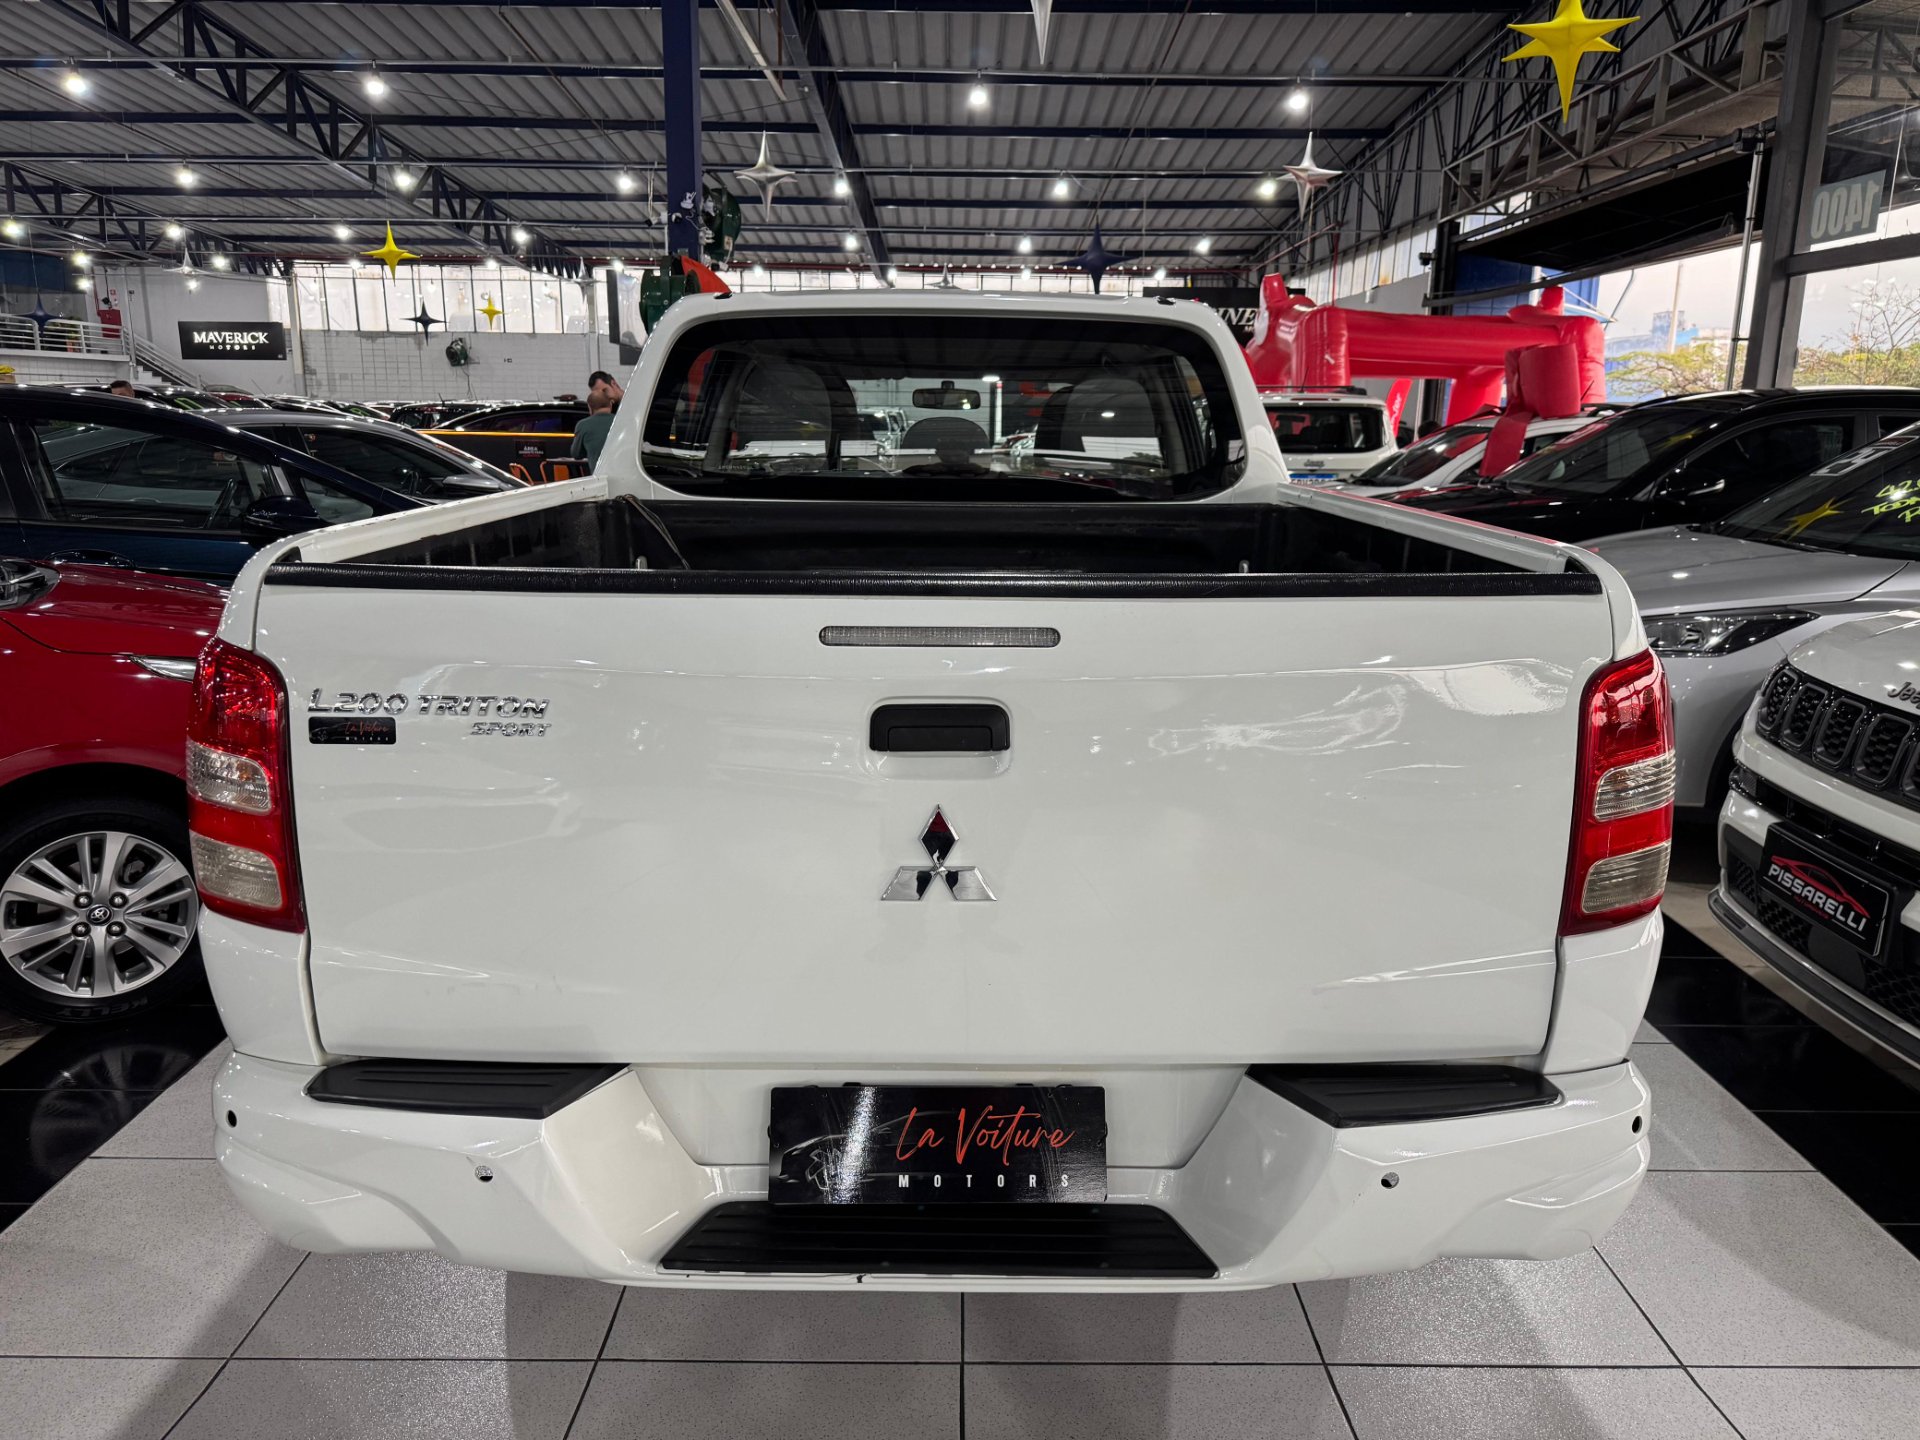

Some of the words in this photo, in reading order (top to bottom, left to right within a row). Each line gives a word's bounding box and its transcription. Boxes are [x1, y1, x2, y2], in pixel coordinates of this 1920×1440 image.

[193, 331, 270, 344] MAVERICK
[307, 688, 409, 715] L200
[417, 695, 550, 719] TRITON
[1887, 681, 1920, 710] Jee
[470, 722, 552, 737] SPORT
[1768, 863, 1867, 932] PISSARELLI
[56, 996, 148, 1017] KELLY
[896, 1106, 945, 1161] La
[955, 1105, 1076, 1166] Voiture
[898, 1174, 1069, 1188] MOTORS
